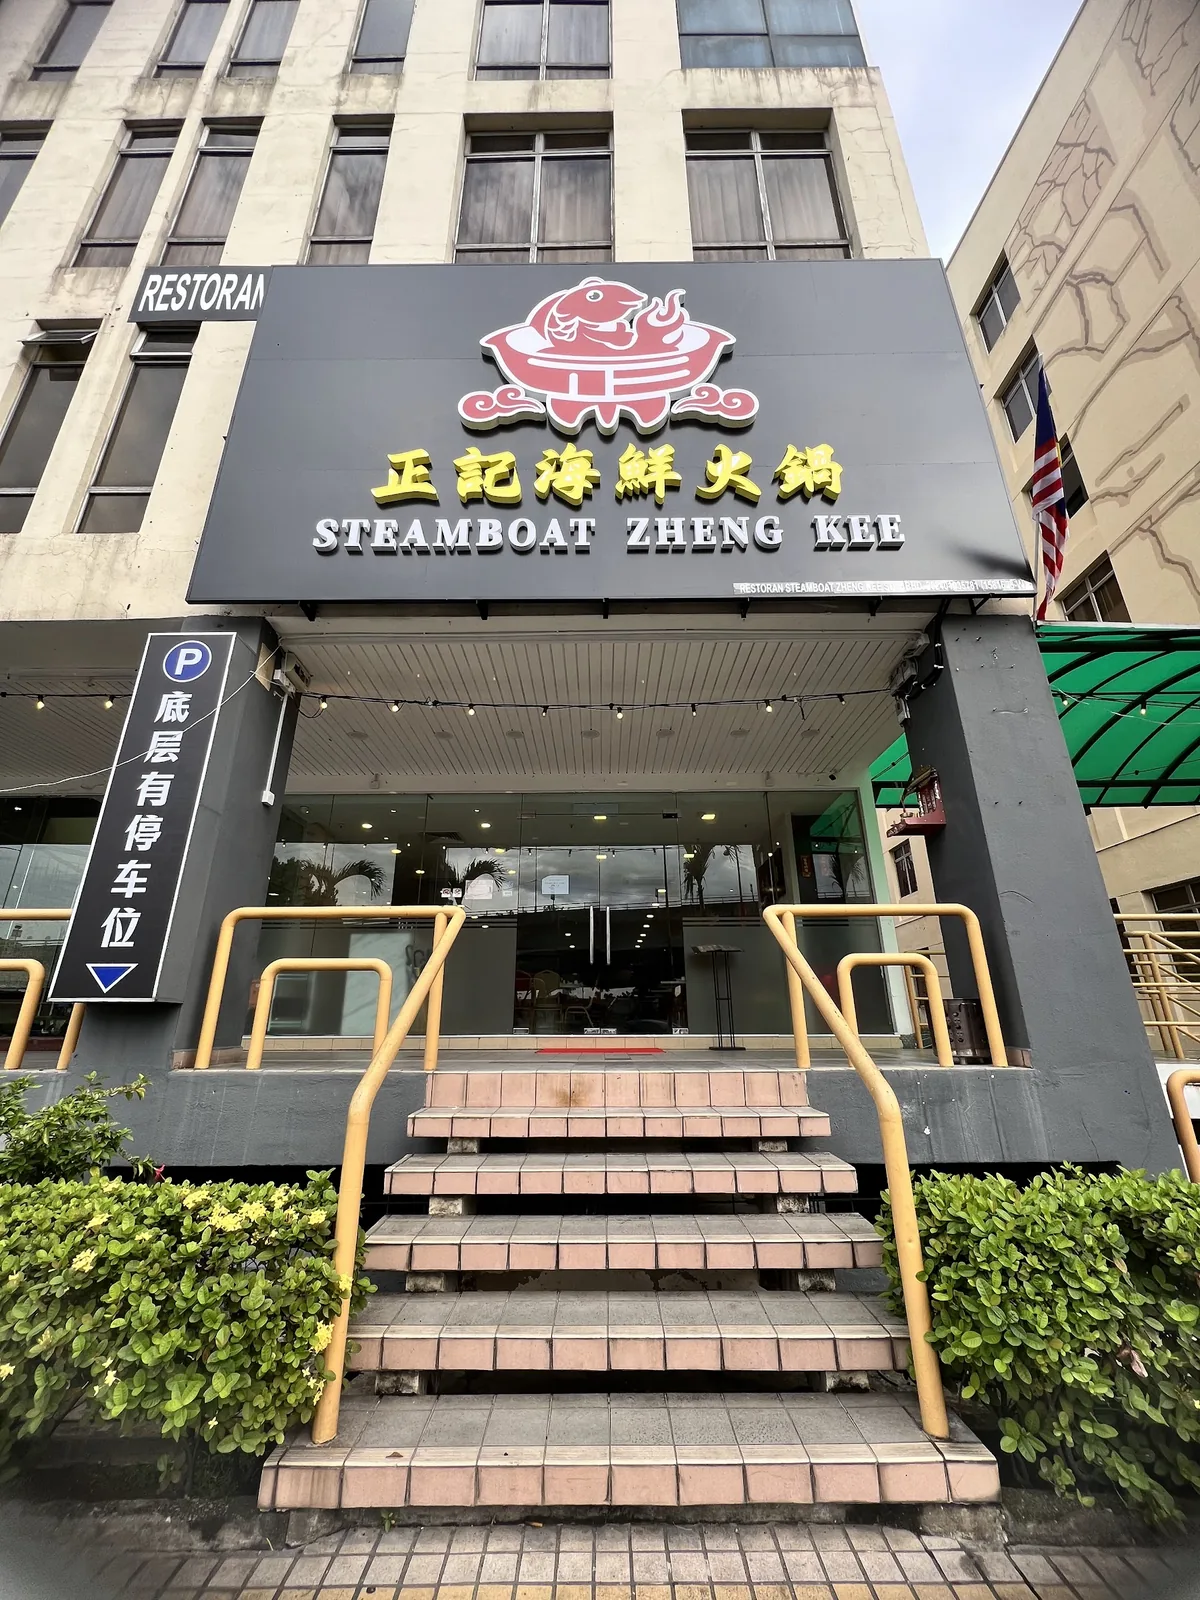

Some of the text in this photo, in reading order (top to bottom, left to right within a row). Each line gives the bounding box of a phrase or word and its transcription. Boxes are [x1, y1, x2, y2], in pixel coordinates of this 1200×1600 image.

[370, 443, 843, 505] 正記海鮮火鍋
[312, 514, 905, 552] STEAMBOAT ZHENG KEE
[739, 583, 782, 593] RESTORAN
[785, 582, 834, 593] STEAMBOAT
[835, 582, 864, 592] ZHENG
[174, 649, 203, 675] P
[100, 691, 193, 948] 底层有停车位
